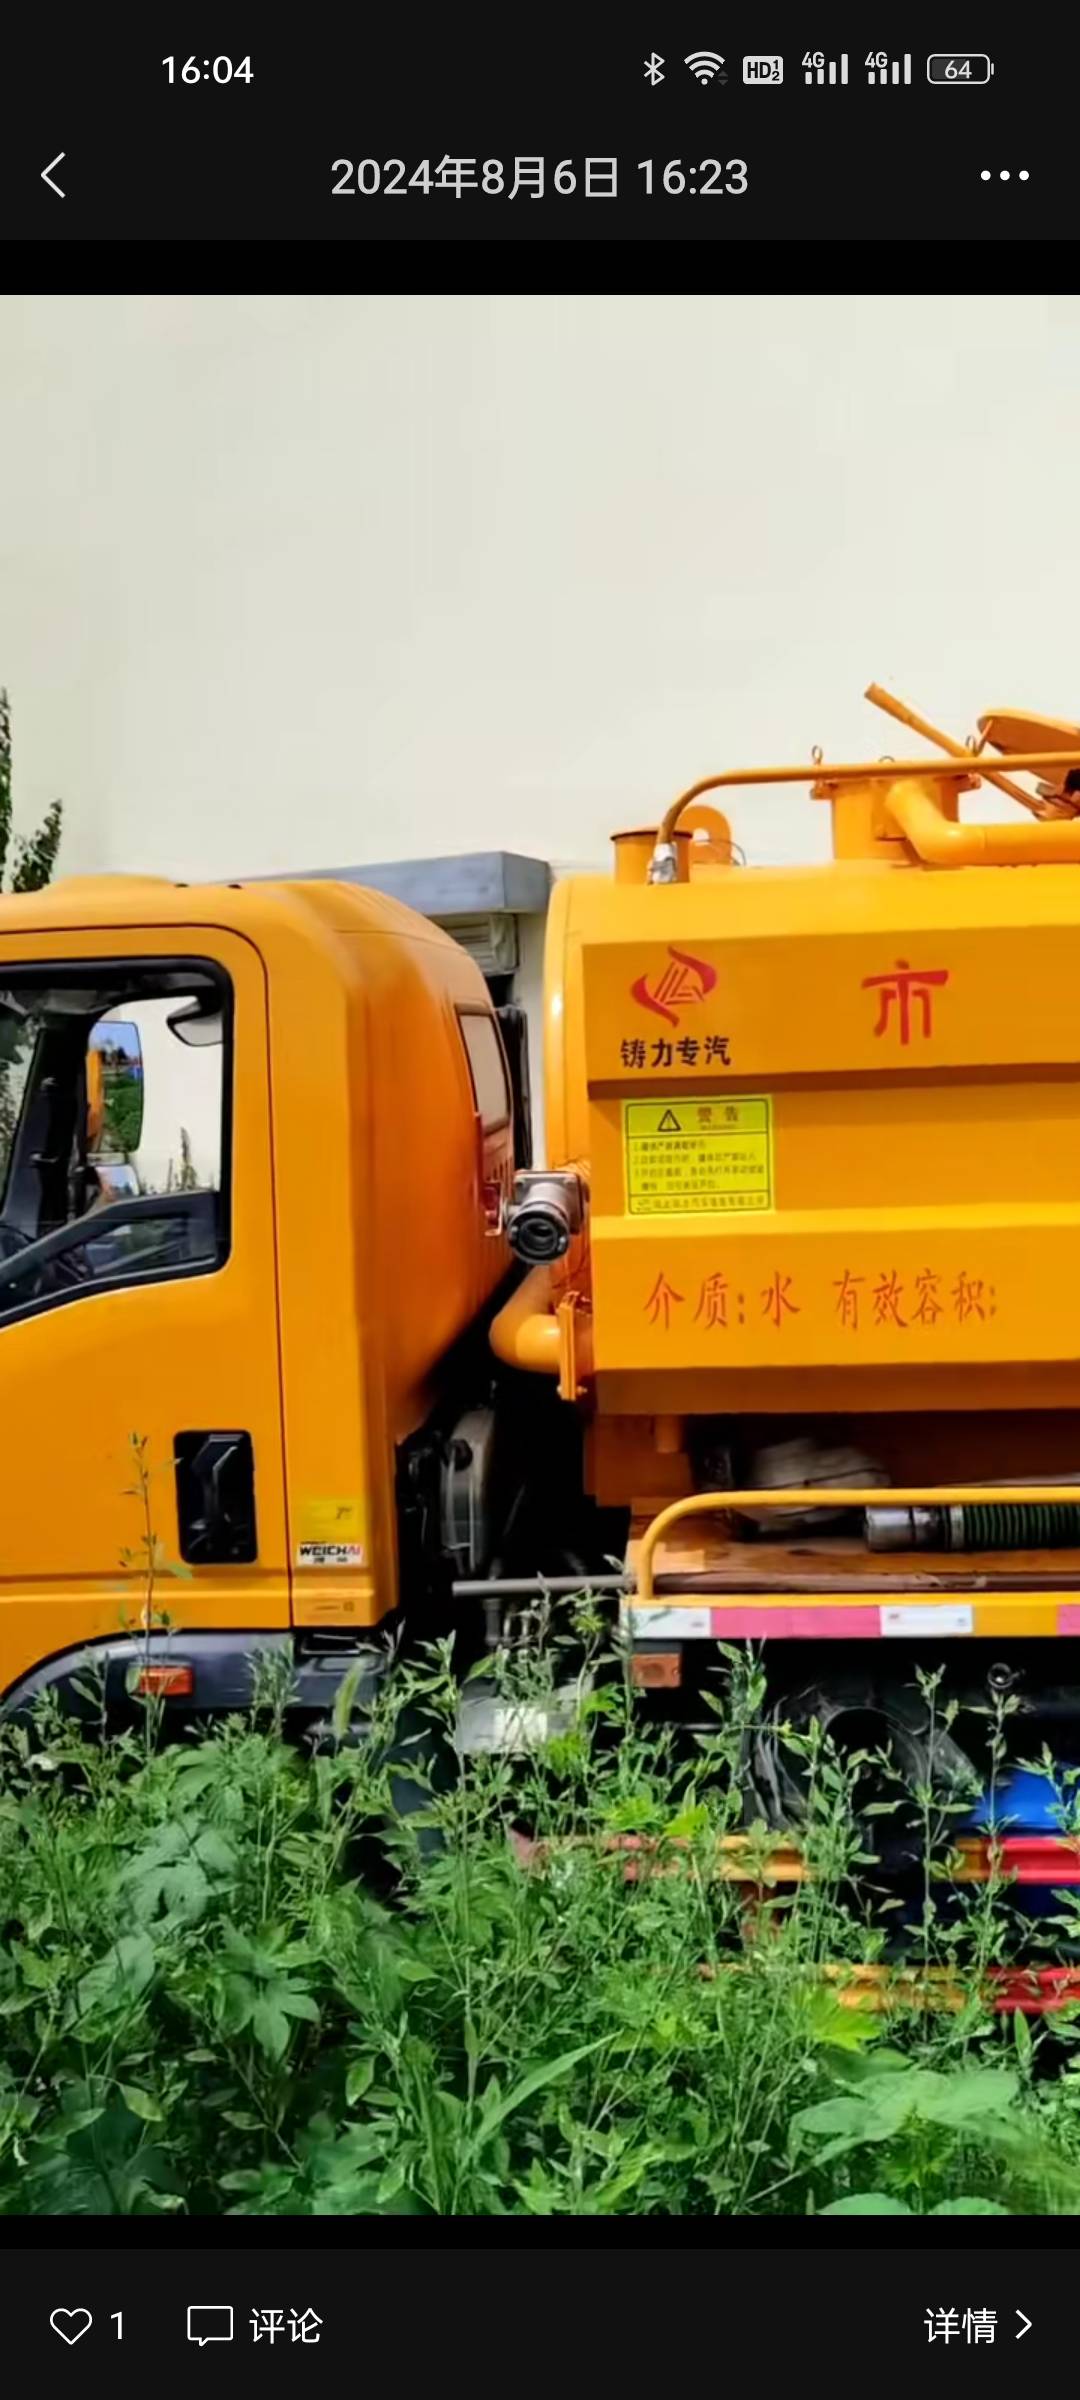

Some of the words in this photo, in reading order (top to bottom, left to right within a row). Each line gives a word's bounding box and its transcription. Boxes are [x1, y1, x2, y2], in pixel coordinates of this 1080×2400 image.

[862, 960, 949, 1046] 市
[620, 1036, 731, 1069] 铸力专汽
[299, 1545, 361, 1556] WEICHAI
